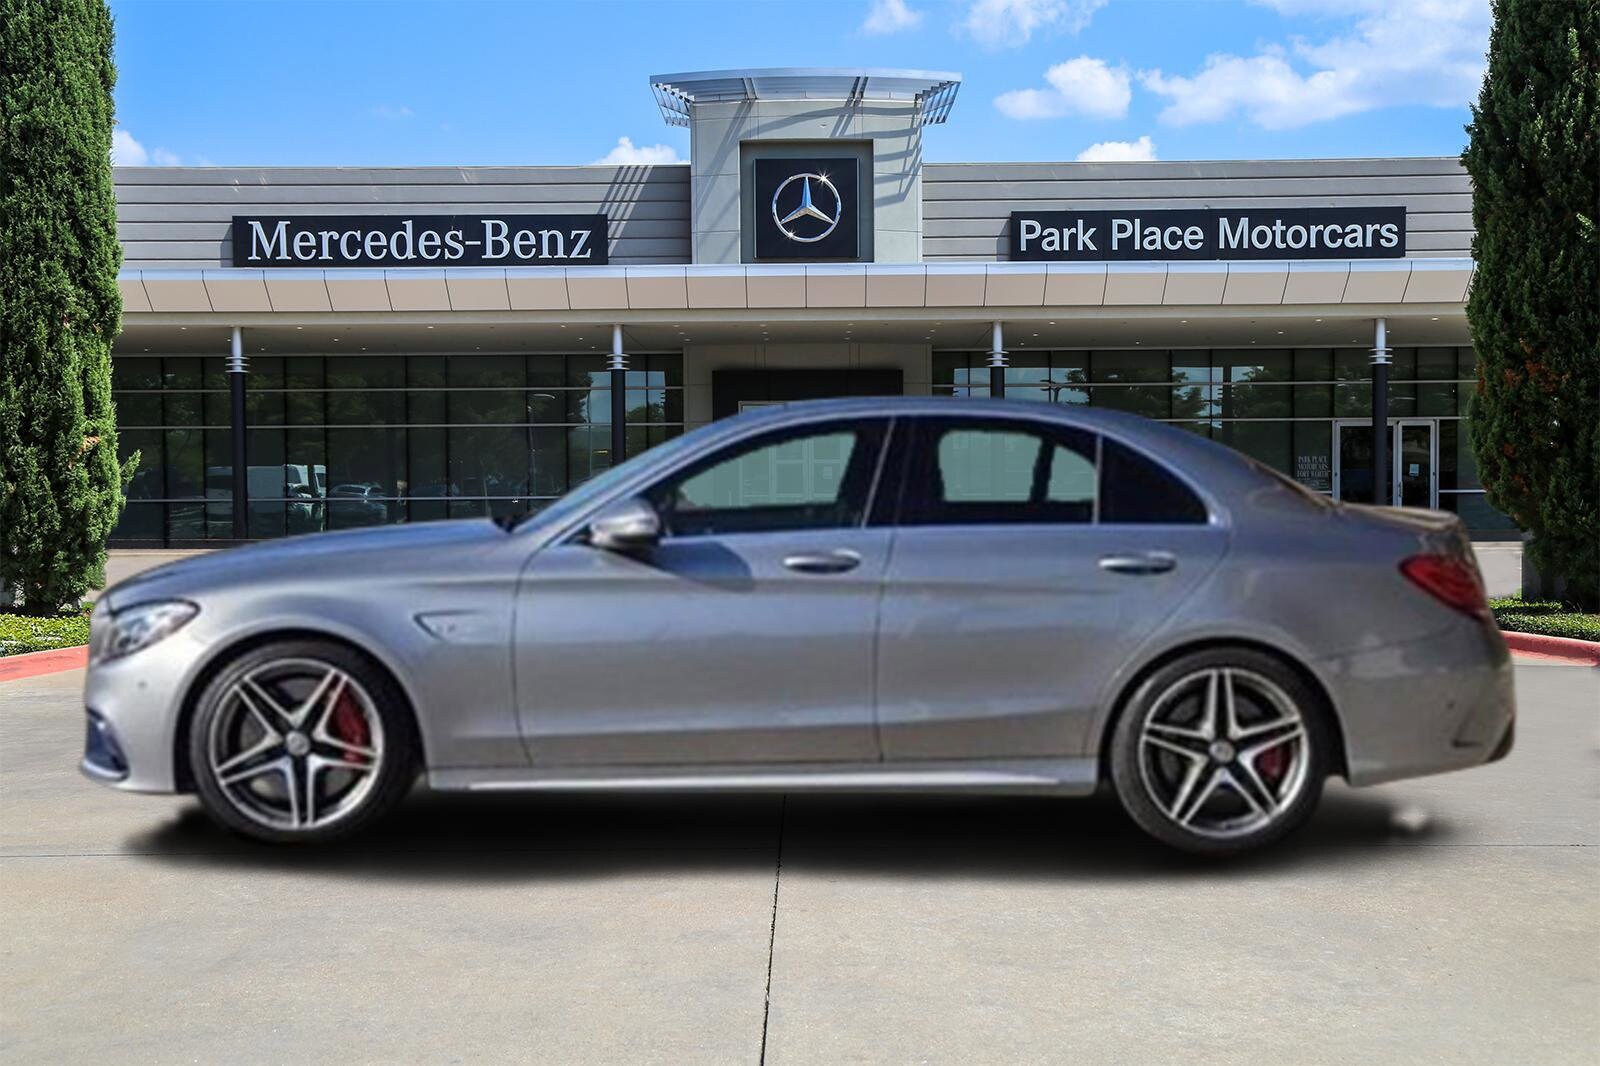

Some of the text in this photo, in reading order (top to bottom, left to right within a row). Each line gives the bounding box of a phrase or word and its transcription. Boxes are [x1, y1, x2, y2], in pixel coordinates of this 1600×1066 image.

[247, 219, 592, 261] Mercedes-Benz
[1019, 217, 1399, 252] Park Place Motorcars
